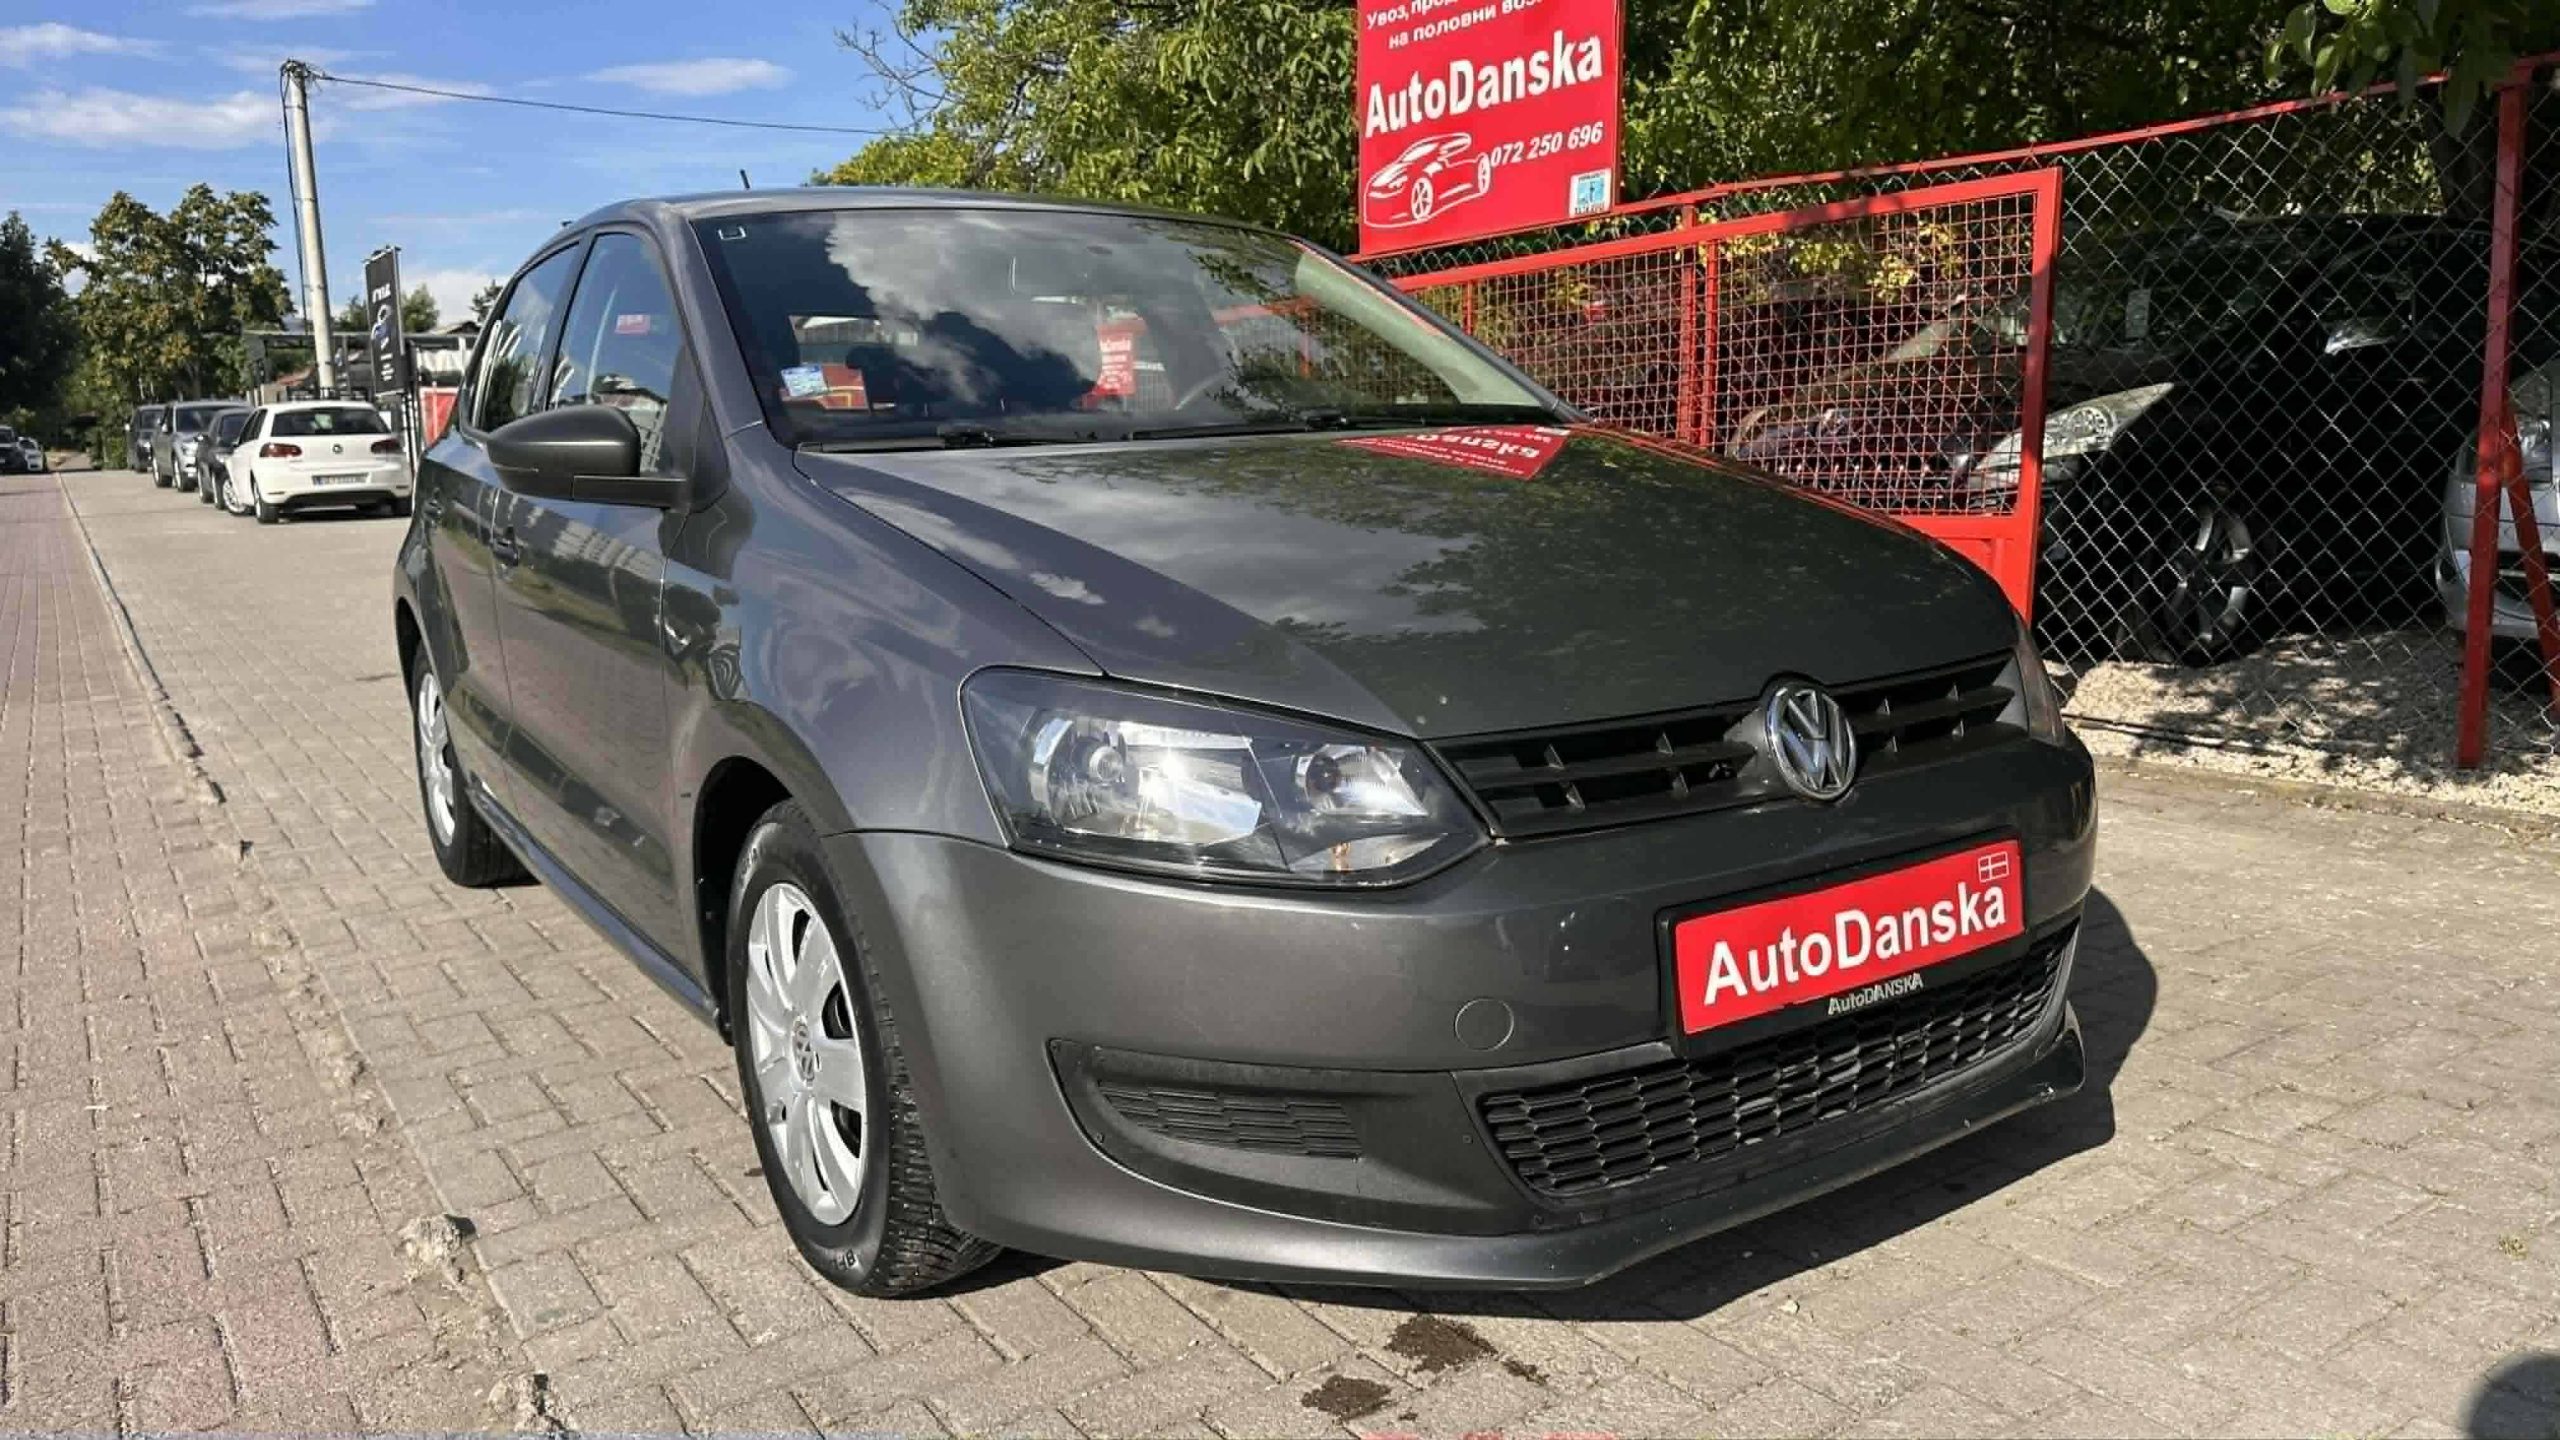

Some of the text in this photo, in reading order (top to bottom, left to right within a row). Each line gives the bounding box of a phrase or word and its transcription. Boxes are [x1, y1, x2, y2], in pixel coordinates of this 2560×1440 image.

[1389, 32, 1409, 49] на
[1413, 5, 1496, 42] половни
[1365, 30, 1602, 138] AutoDanska
[1490, 121, 1603, 168] 072 250 696
[1703, 882, 2006, 1006] AutoDanska
[1827, 972, 1924, 1015] AutoDANSKA
